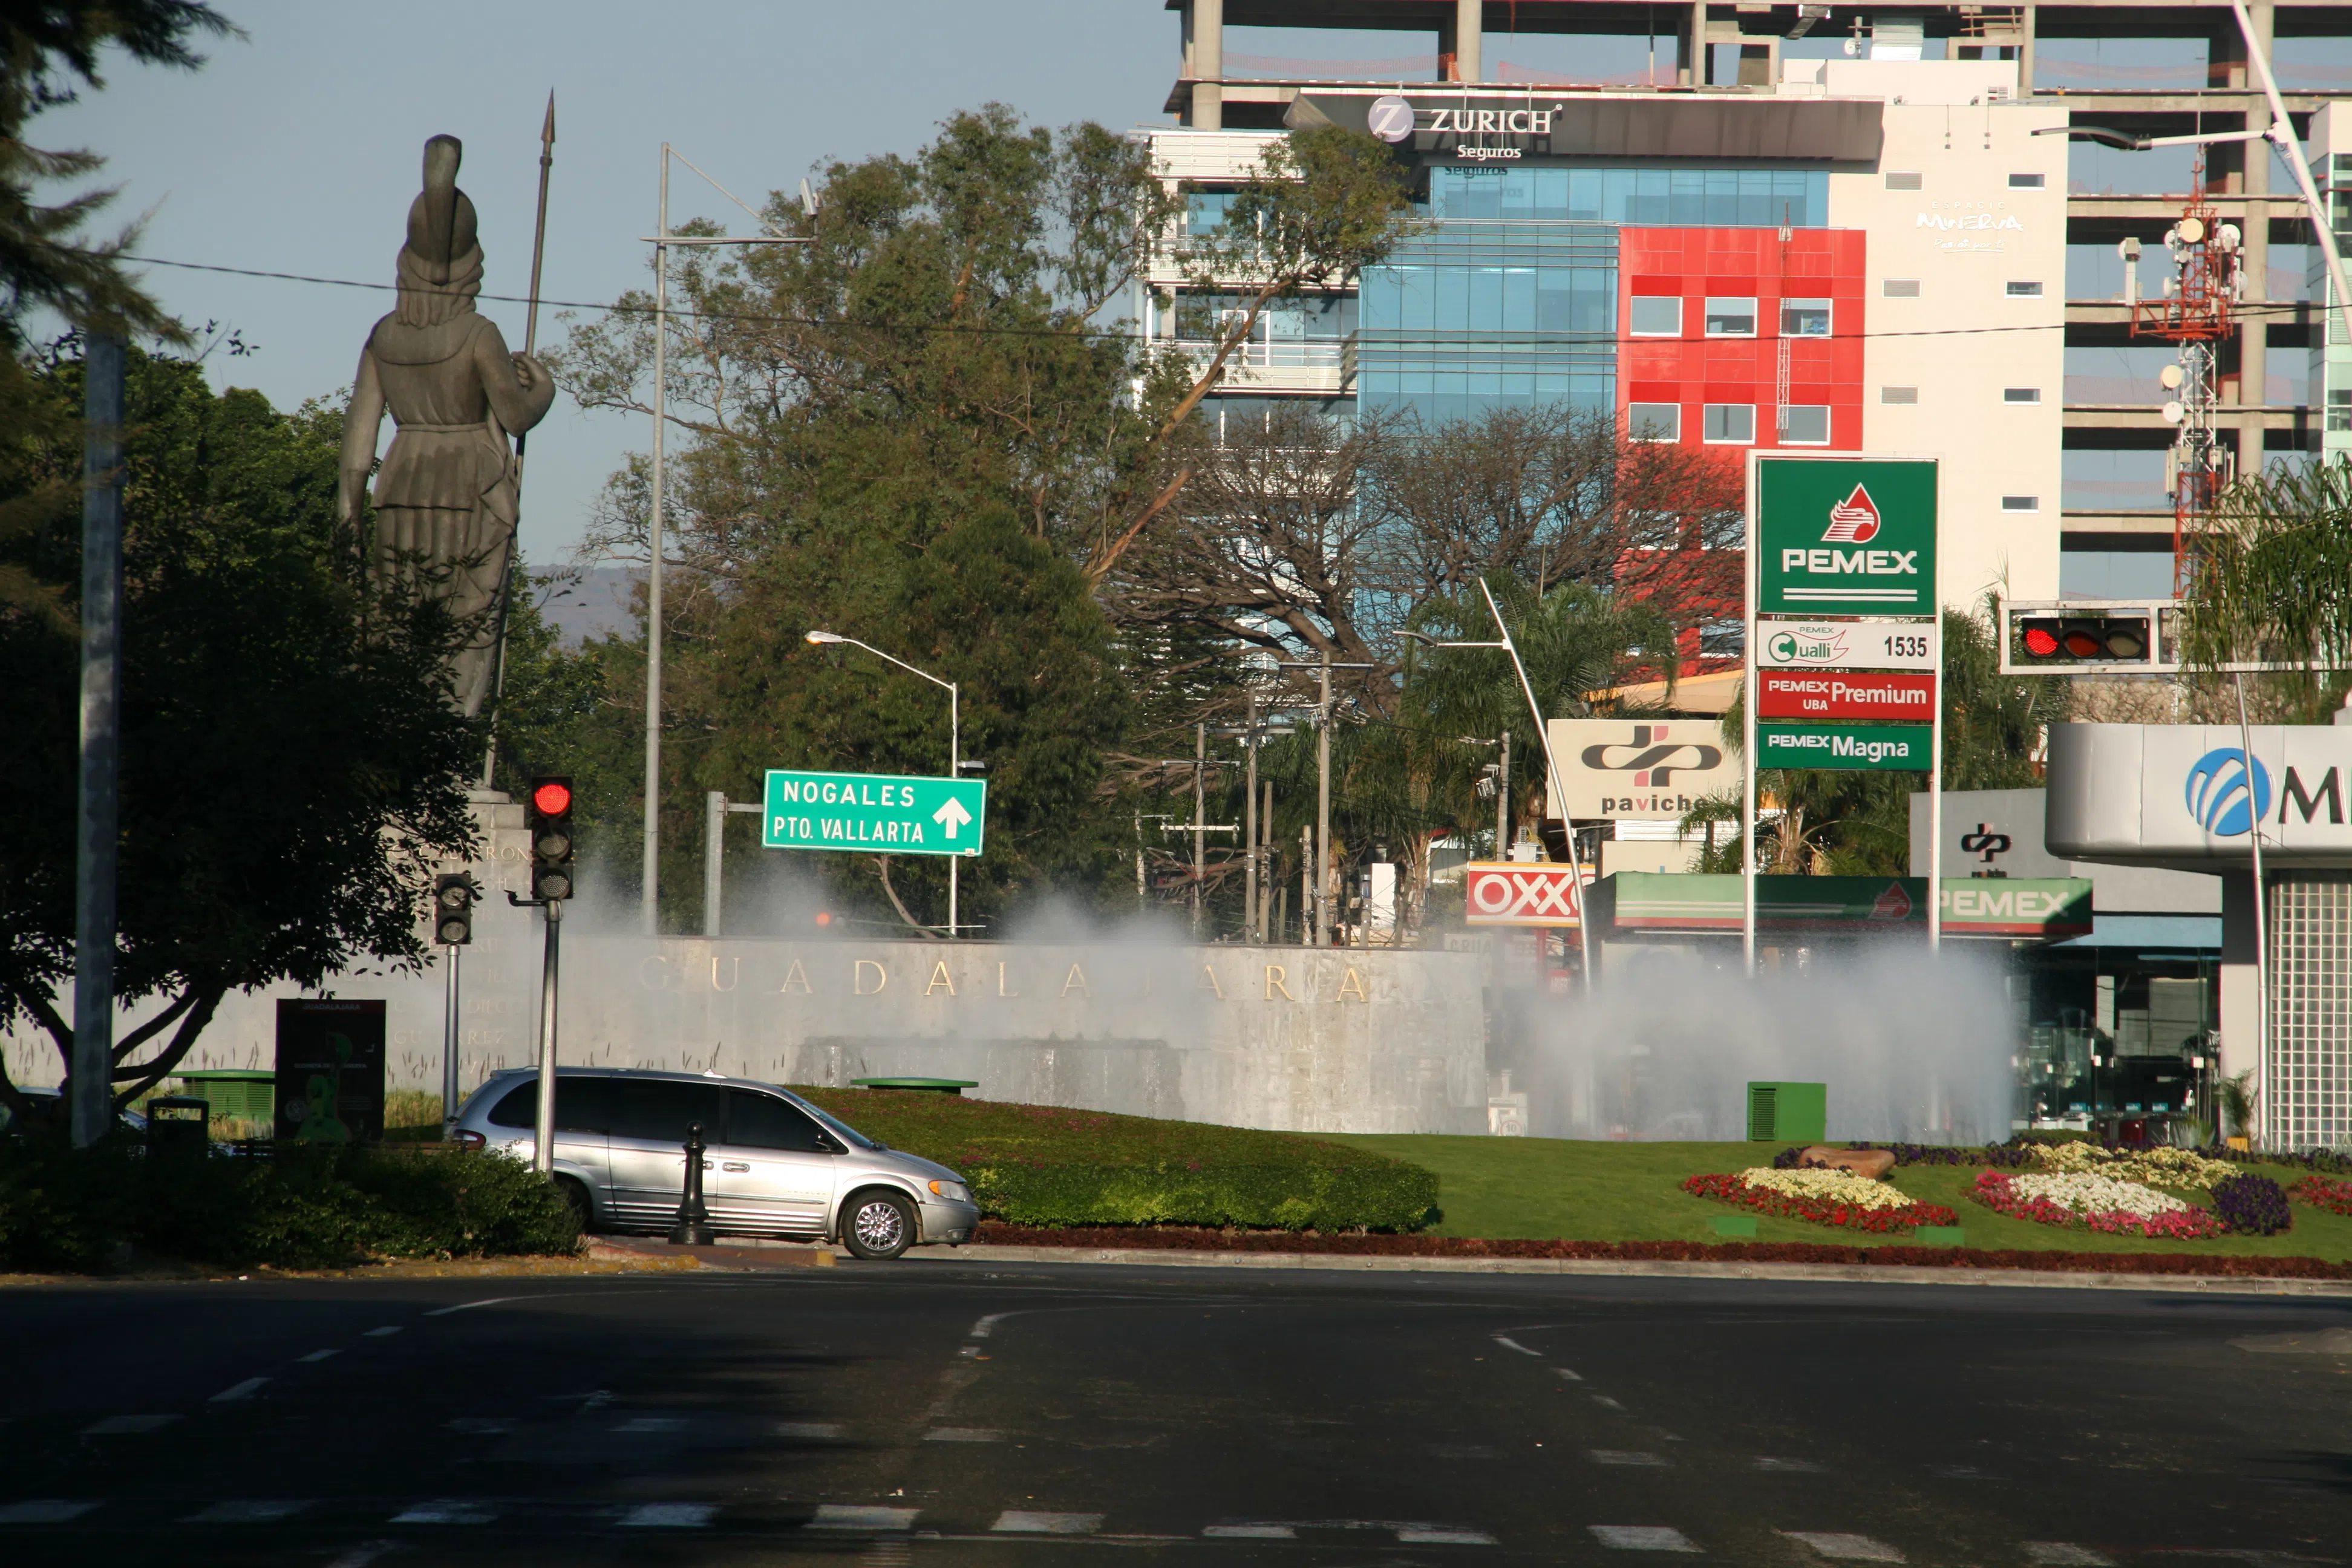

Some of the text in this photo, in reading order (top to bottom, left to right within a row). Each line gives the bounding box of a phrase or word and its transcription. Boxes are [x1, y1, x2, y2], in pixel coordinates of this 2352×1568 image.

[1429, 109, 1551, 133] ZURICH
[1457, 144, 1522, 161] Seguros
[1782, 549, 1918, 573] PEMEX
[1884, 636, 1927, 657] 1535
[1768, 680, 1927, 704] PEMEX Premium
[1803, 699, 1828, 710] UBA
[1768, 734, 1909, 763] PEMEX Magna
[783, 781, 915, 807] NOGALES
[774, 816, 924, 843] PTO. VALLARTA
